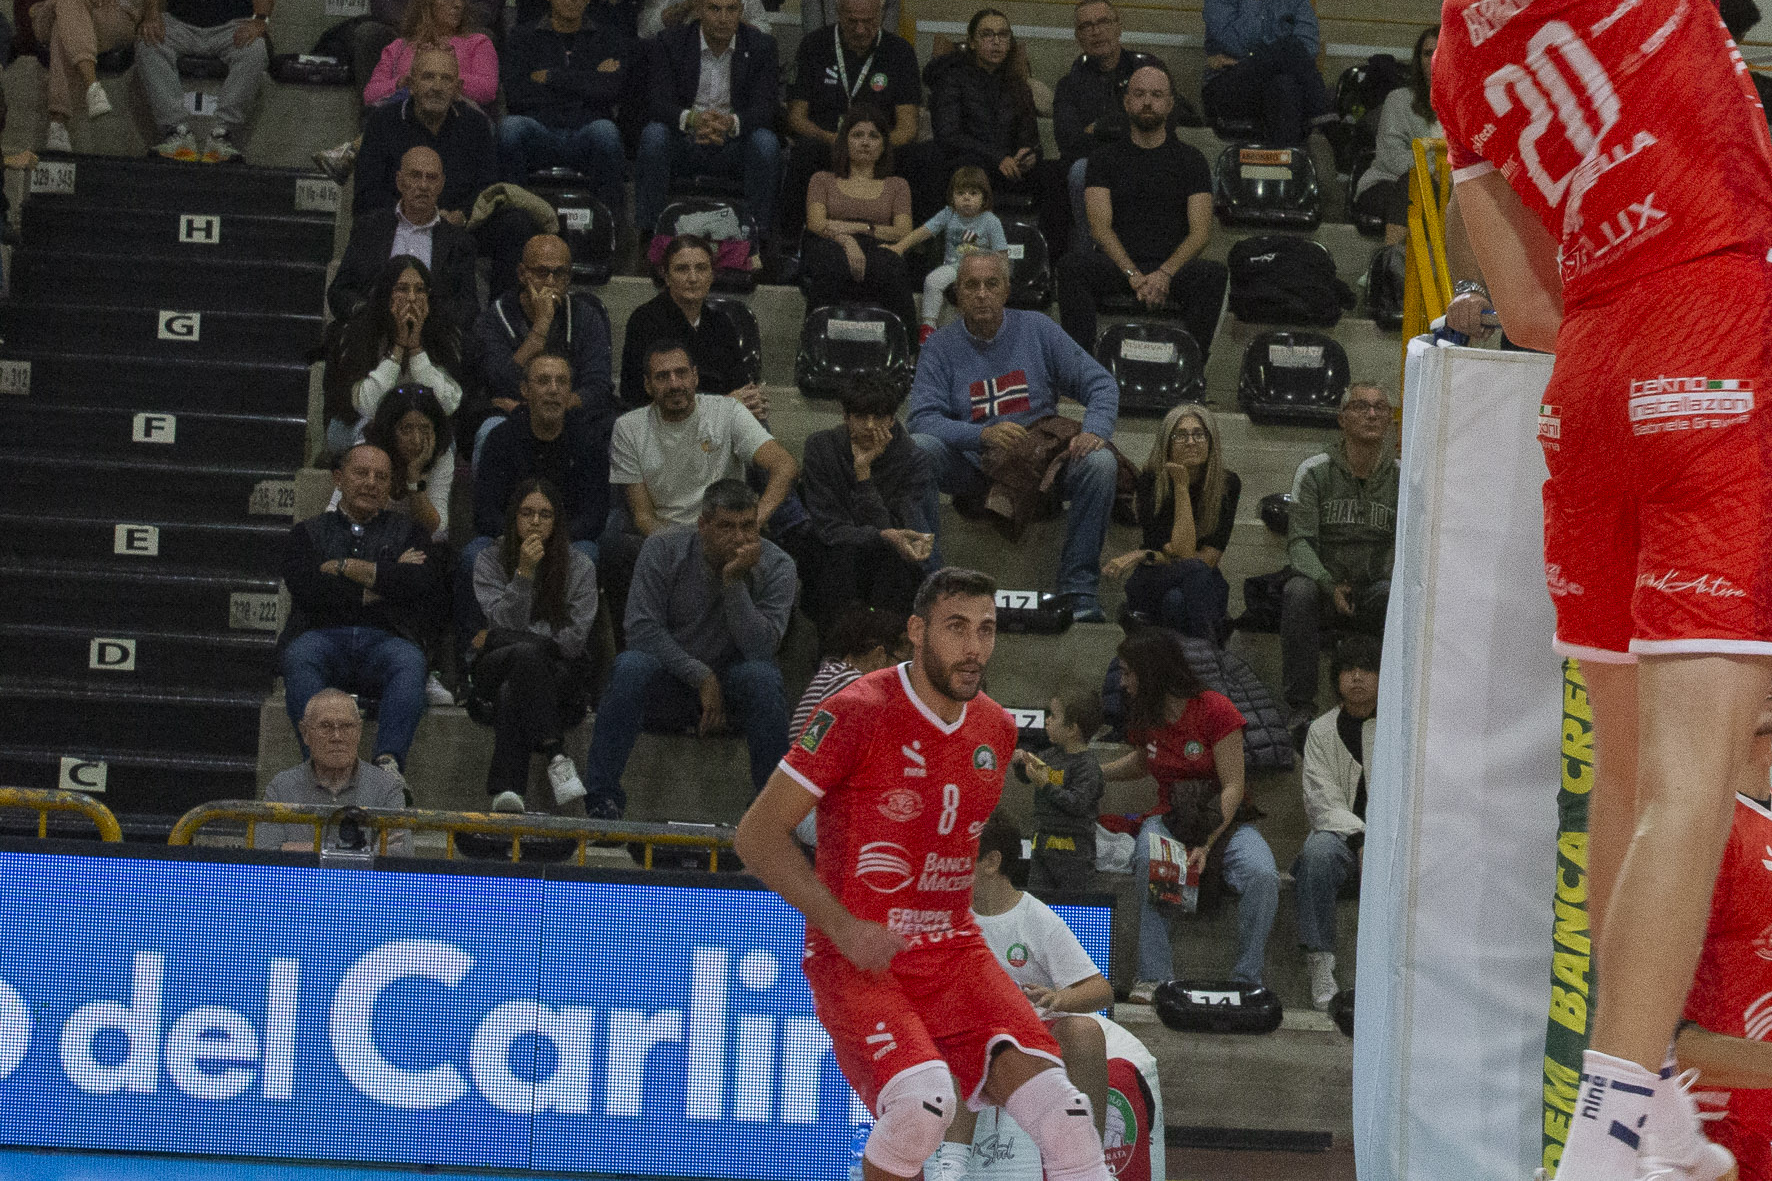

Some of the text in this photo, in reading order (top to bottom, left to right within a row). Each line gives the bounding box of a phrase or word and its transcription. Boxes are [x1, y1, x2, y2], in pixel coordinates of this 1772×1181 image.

[1484, 20, 1621, 207] 20
[185, 219, 213, 240] H
[164, 315, 195, 337] G
[1631, 375, 1707, 397] tekno
[144, 416, 167, 438] F
[125, 528, 149, 551] E
[260, 601, 277, 622] 222
[1002, 595, 1030, 609] 17
[97, 642, 130, 665] D
[68, 762, 99, 787] C
[937, 783, 960, 835] 8
[1548, 831, 1591, 1036] BANCA
[60, 950, 299, 1101] del
[329, 937, 874, 1125] Carlin
[1581, 1074, 1608, 1120] nine
